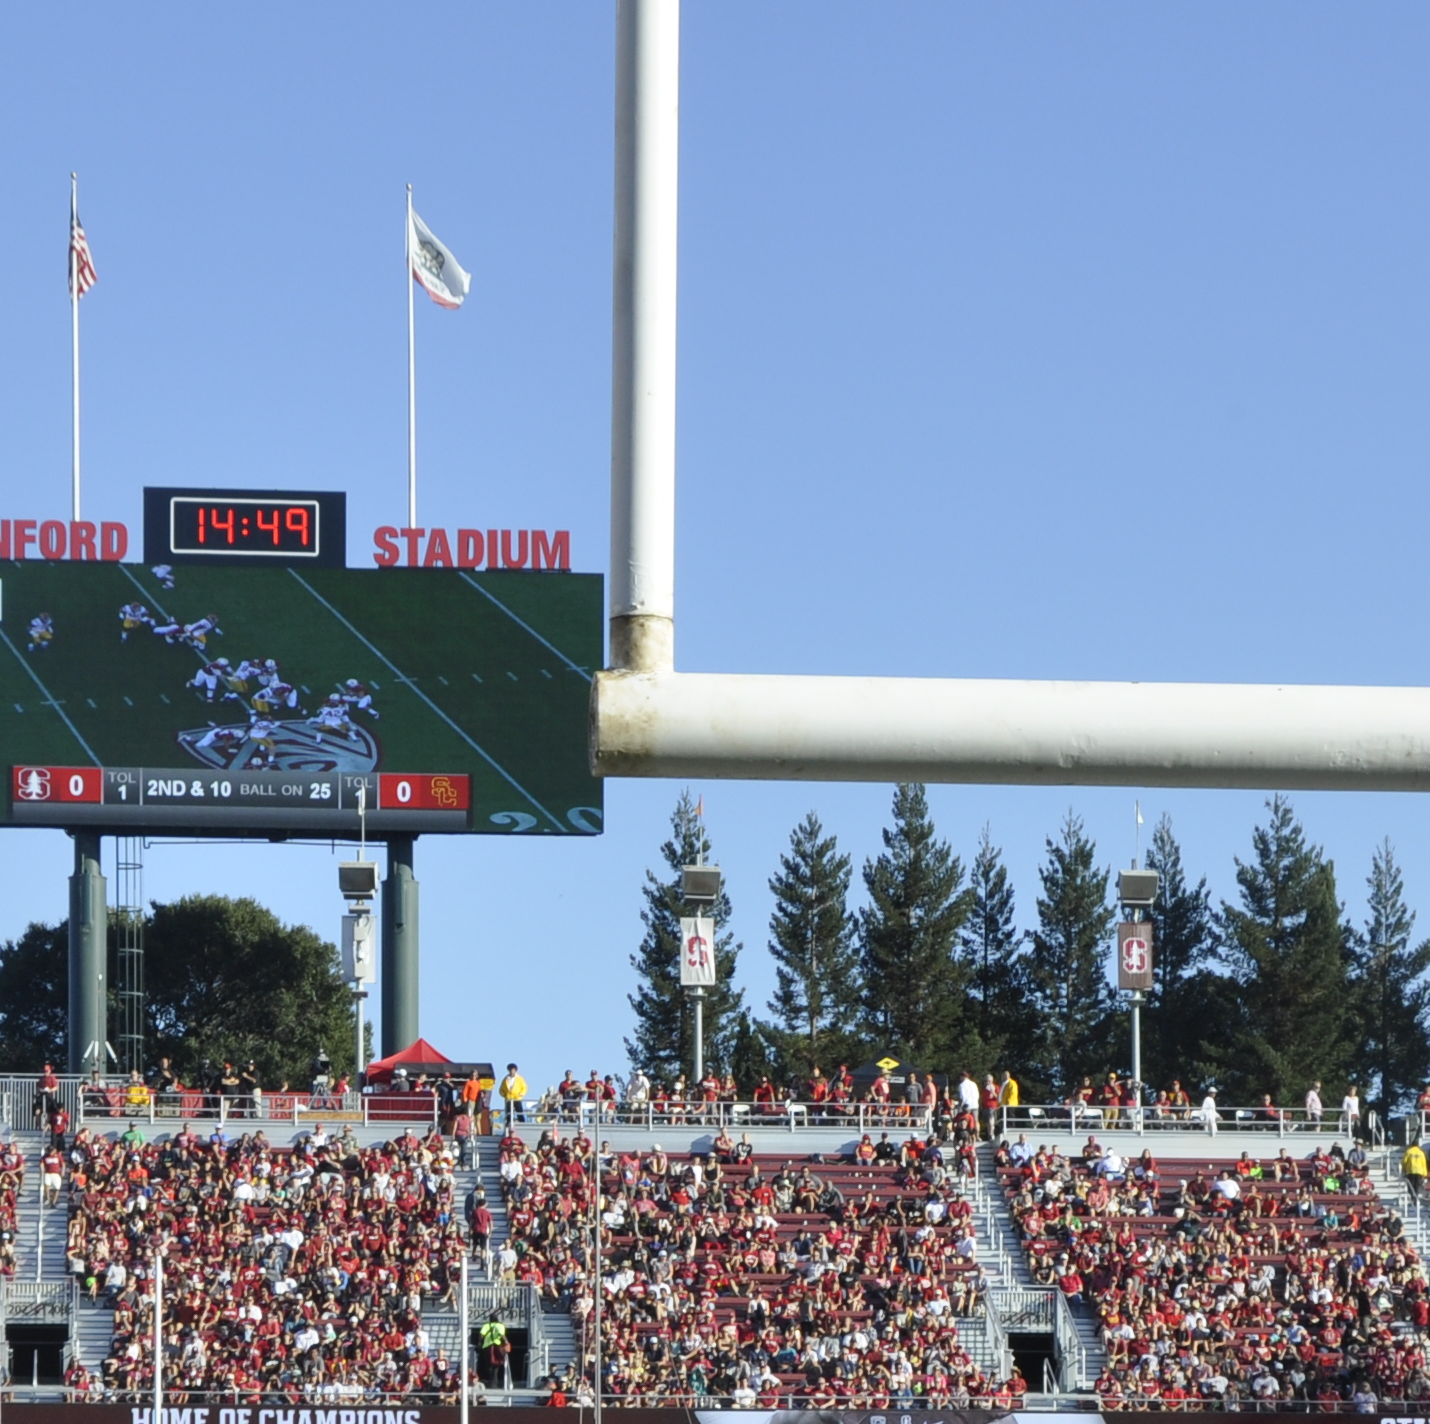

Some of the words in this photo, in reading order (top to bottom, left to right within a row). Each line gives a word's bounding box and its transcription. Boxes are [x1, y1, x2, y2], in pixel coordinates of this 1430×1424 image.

[196, 507, 310, 547] 14:49
[373, 526, 572, 571] STADIUM
[68, 774, 85, 796] 0
[108, 771, 137, 785] TOL
[344, 776, 373, 789] TOL
[117, 784, 127, 801] 1
[146, 779, 187, 798] 2ND
[189, 780, 206, 798] &
[211, 780, 232, 798] 10
[239, 783, 277, 797] BALL
[281, 785, 304, 797] ON
[309, 782, 332, 800] 25
[396, 780, 412, 802] 0
